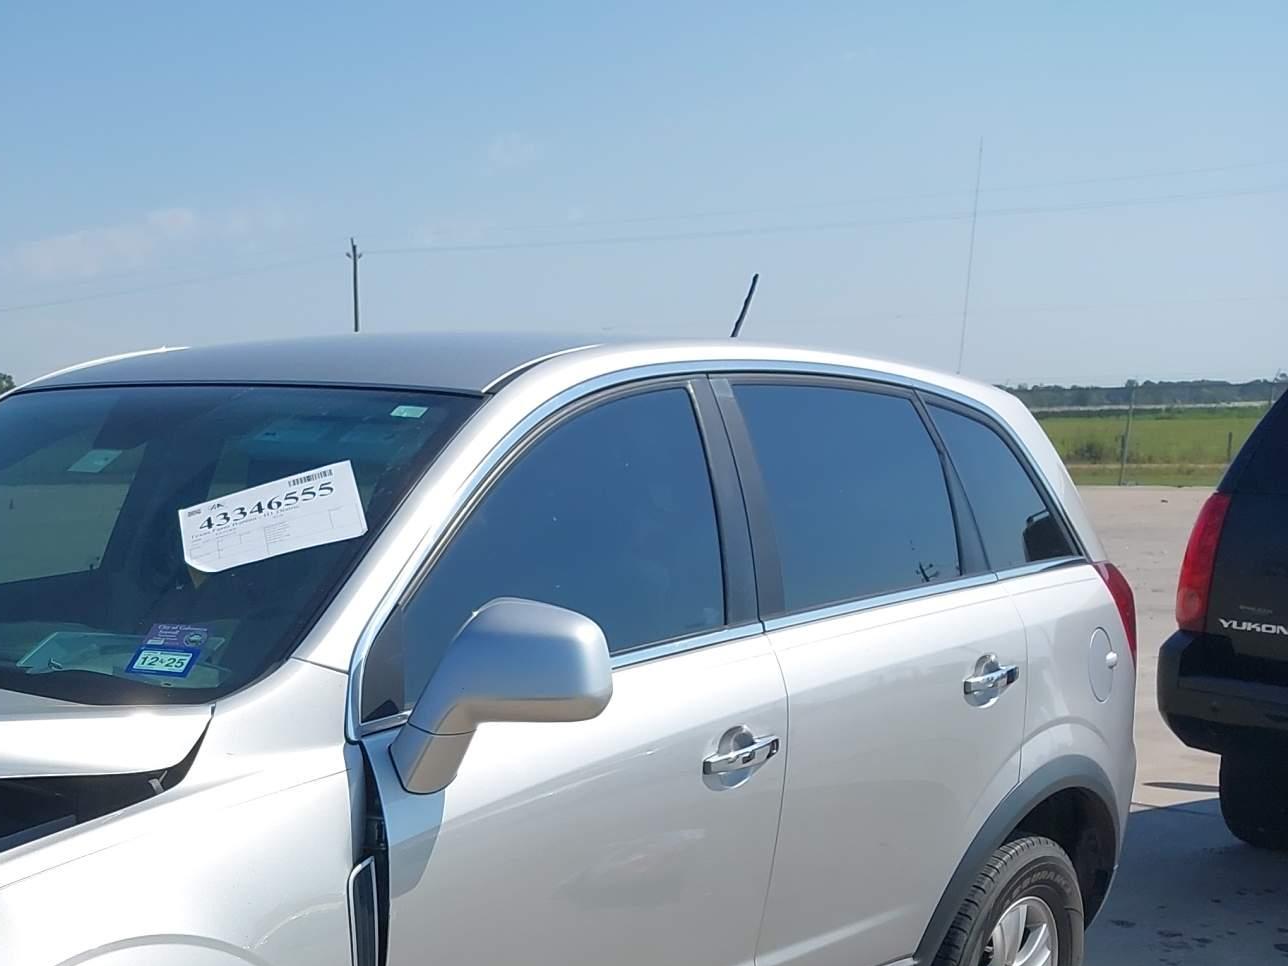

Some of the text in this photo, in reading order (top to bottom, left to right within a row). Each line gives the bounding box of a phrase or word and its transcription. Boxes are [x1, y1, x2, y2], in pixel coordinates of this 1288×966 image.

[199, 481, 335, 530] 43346555
[1218, 618, 1288, 636] YUKON
[140, 655, 187, 669] 12 25
